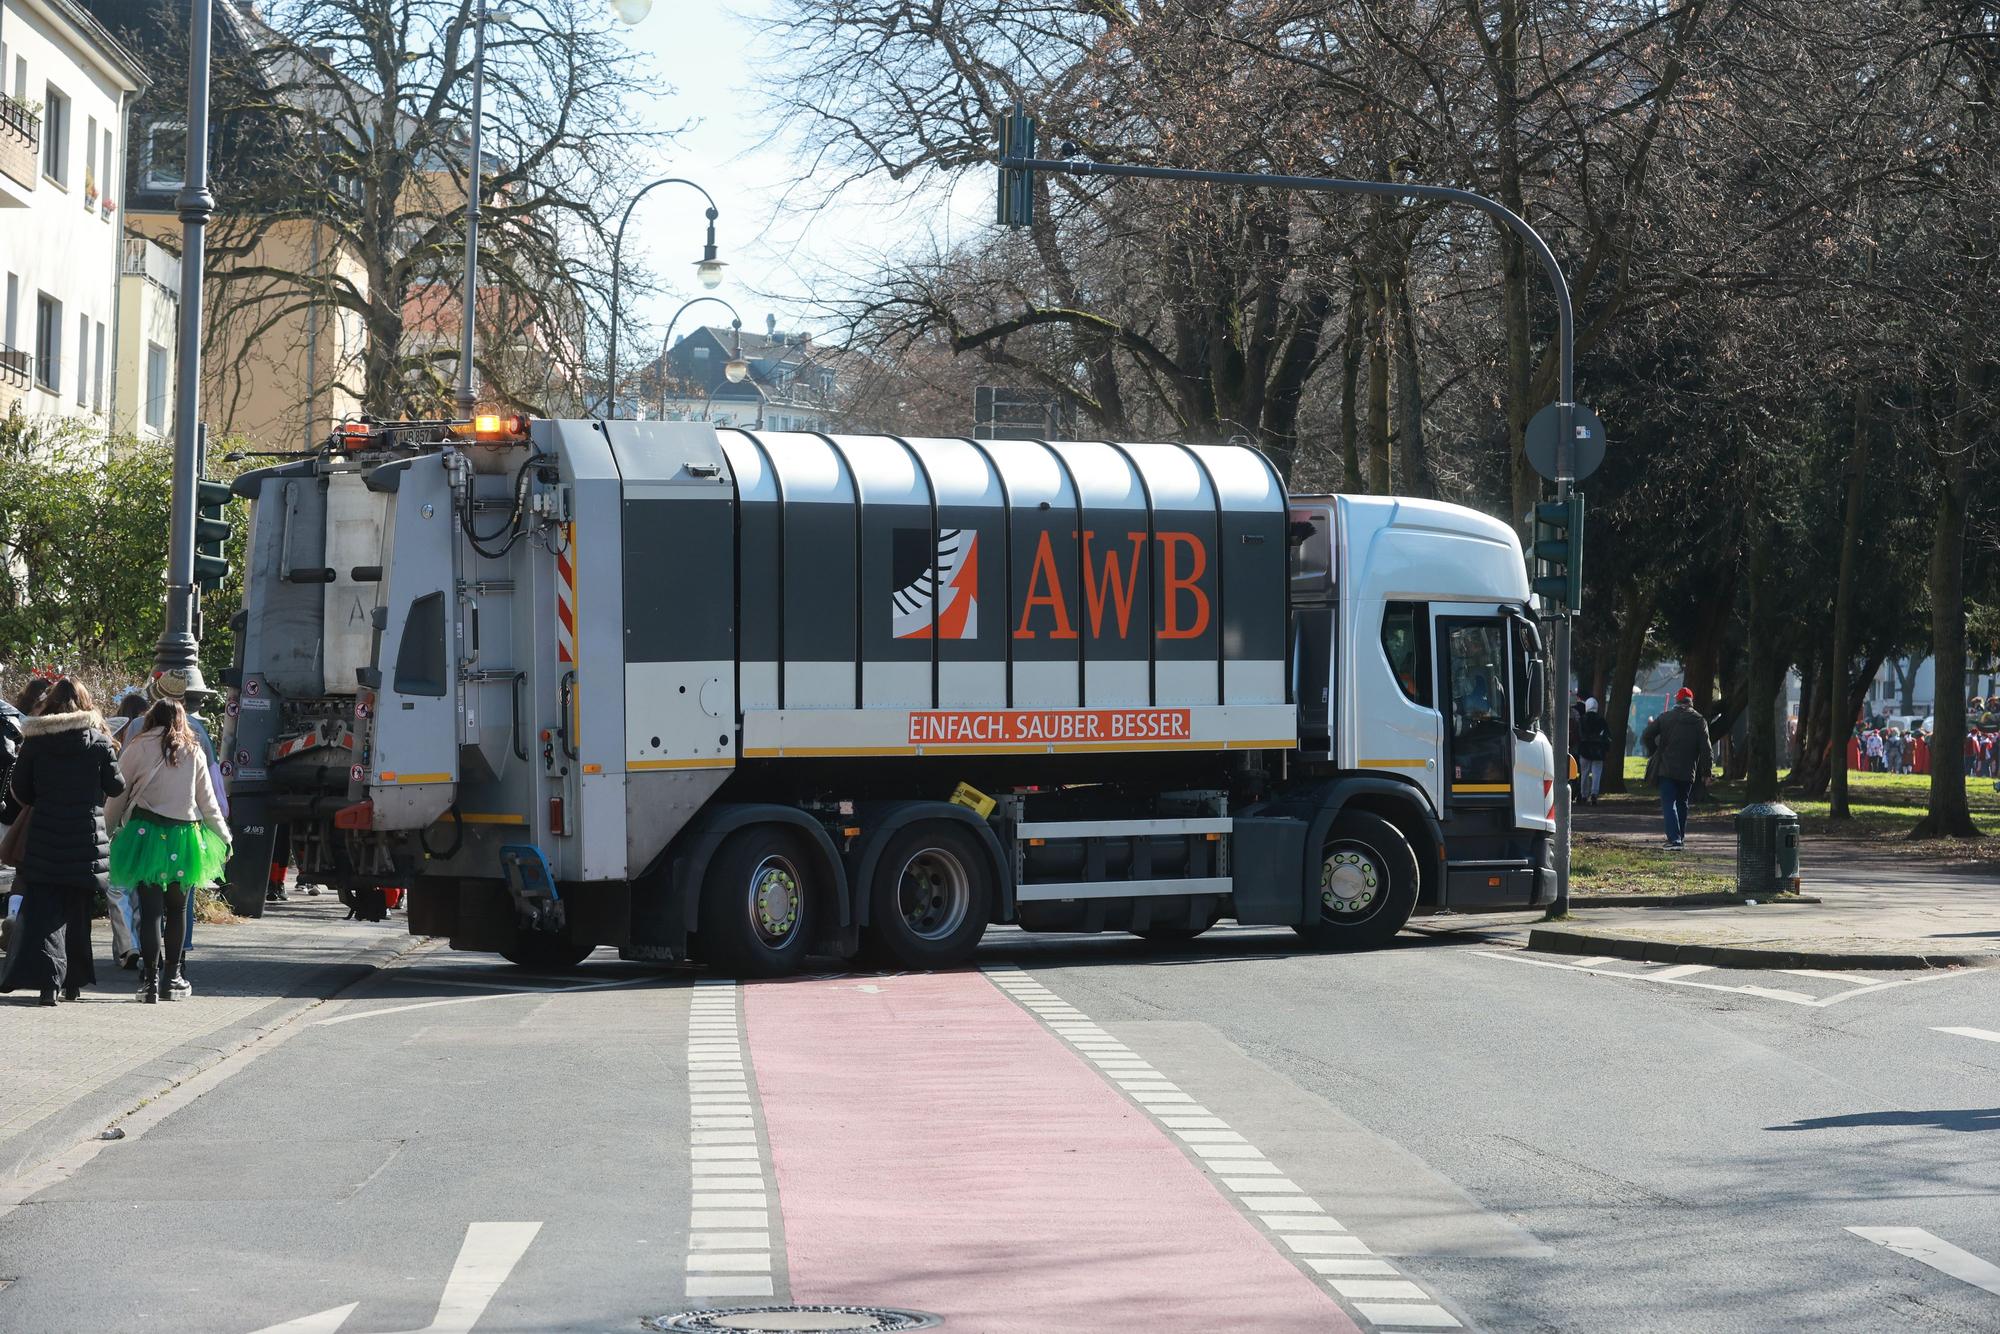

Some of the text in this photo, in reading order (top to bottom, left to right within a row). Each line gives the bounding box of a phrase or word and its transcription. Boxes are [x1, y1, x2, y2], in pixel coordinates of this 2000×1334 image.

[1013, 530, 1210, 639] AWB
[349, 595, 365, 626] A
[910, 713, 1189, 740] EINFACH. SAUBER. BESSER.
